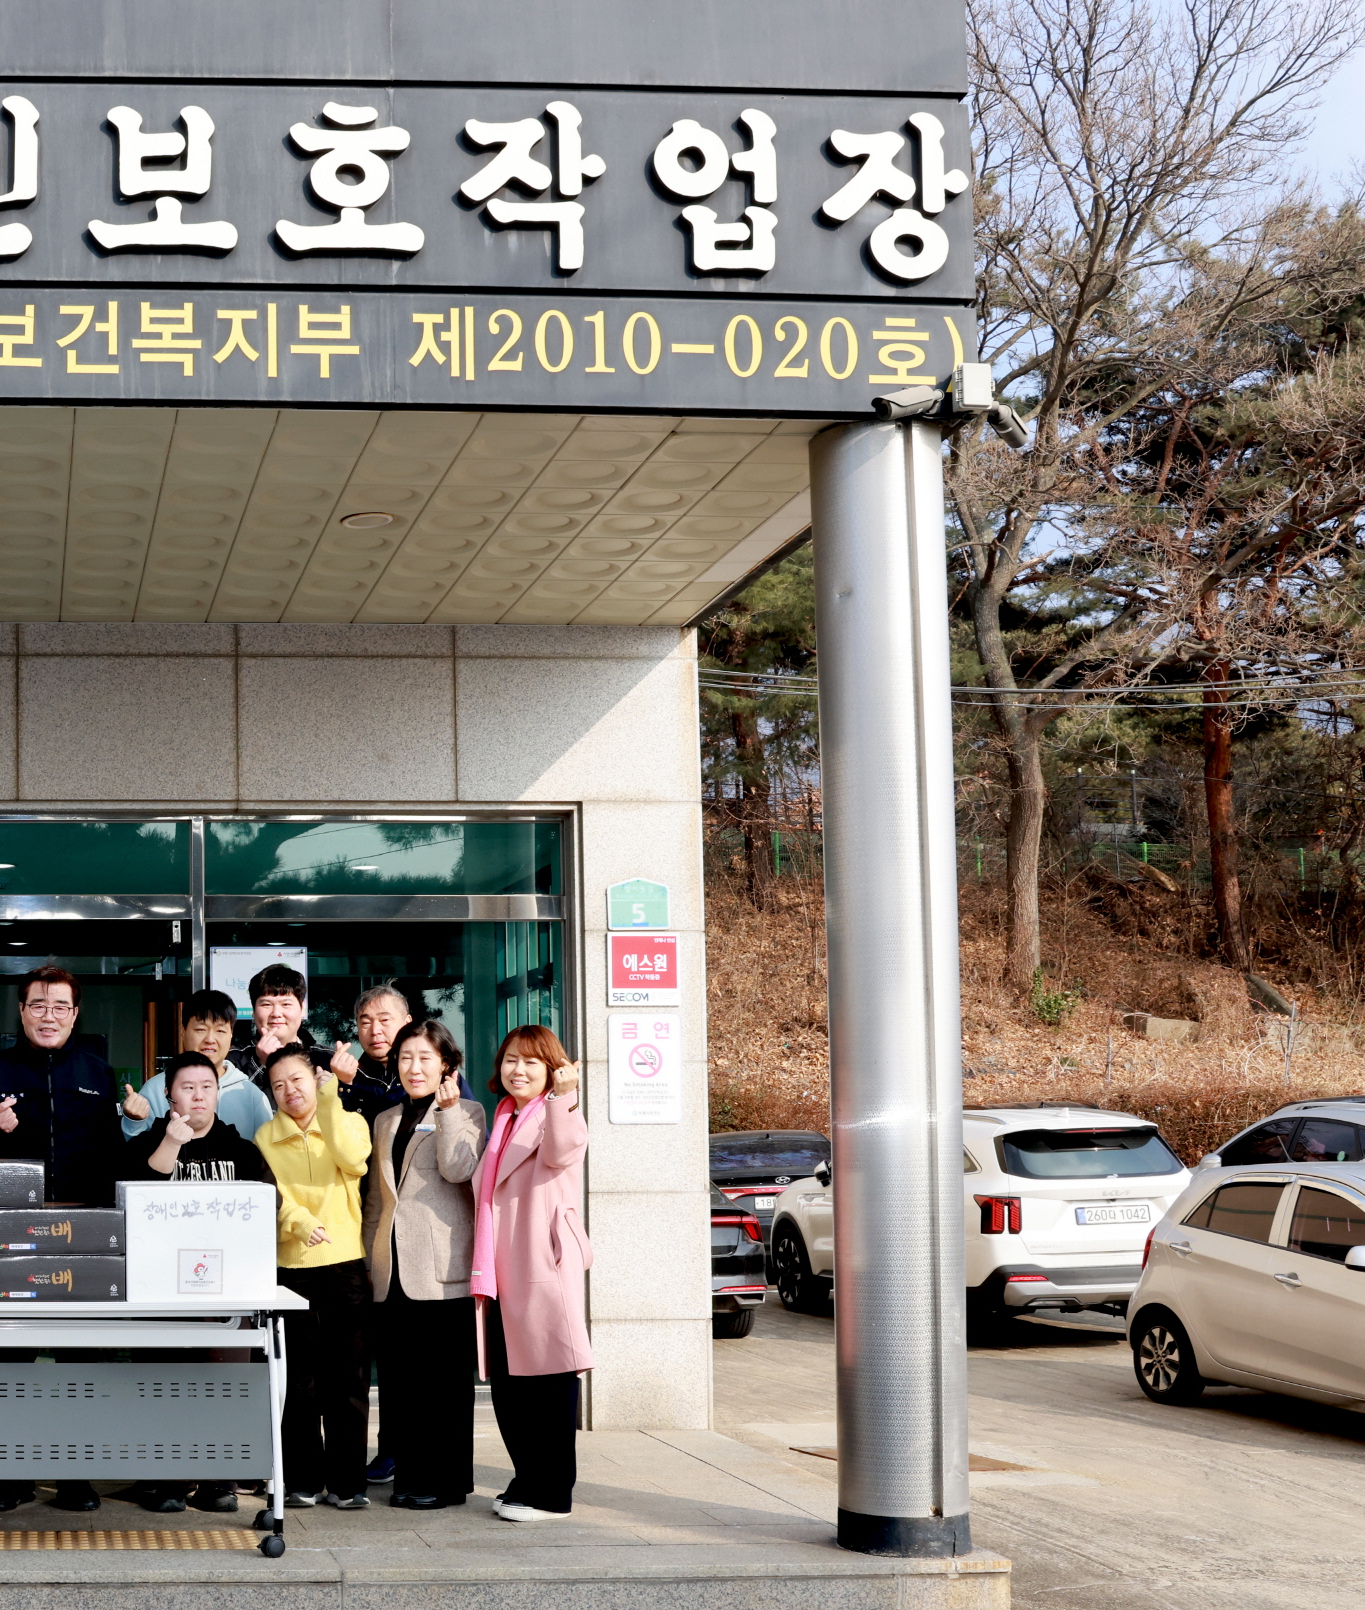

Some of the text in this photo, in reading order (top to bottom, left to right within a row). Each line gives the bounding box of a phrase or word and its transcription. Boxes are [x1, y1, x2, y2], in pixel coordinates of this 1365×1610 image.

[408, 306, 964, 388] 제2010-020호)
[632, 903, 646, 923] 5
[622, 953, 668, 971] 에스원
[612, 993, 649, 1001] SECOM
[1119, 1208, 1147, 1220] 1042
[51, 1220, 72, 1244] 배
[51, 1268, 73, 1292] 배
